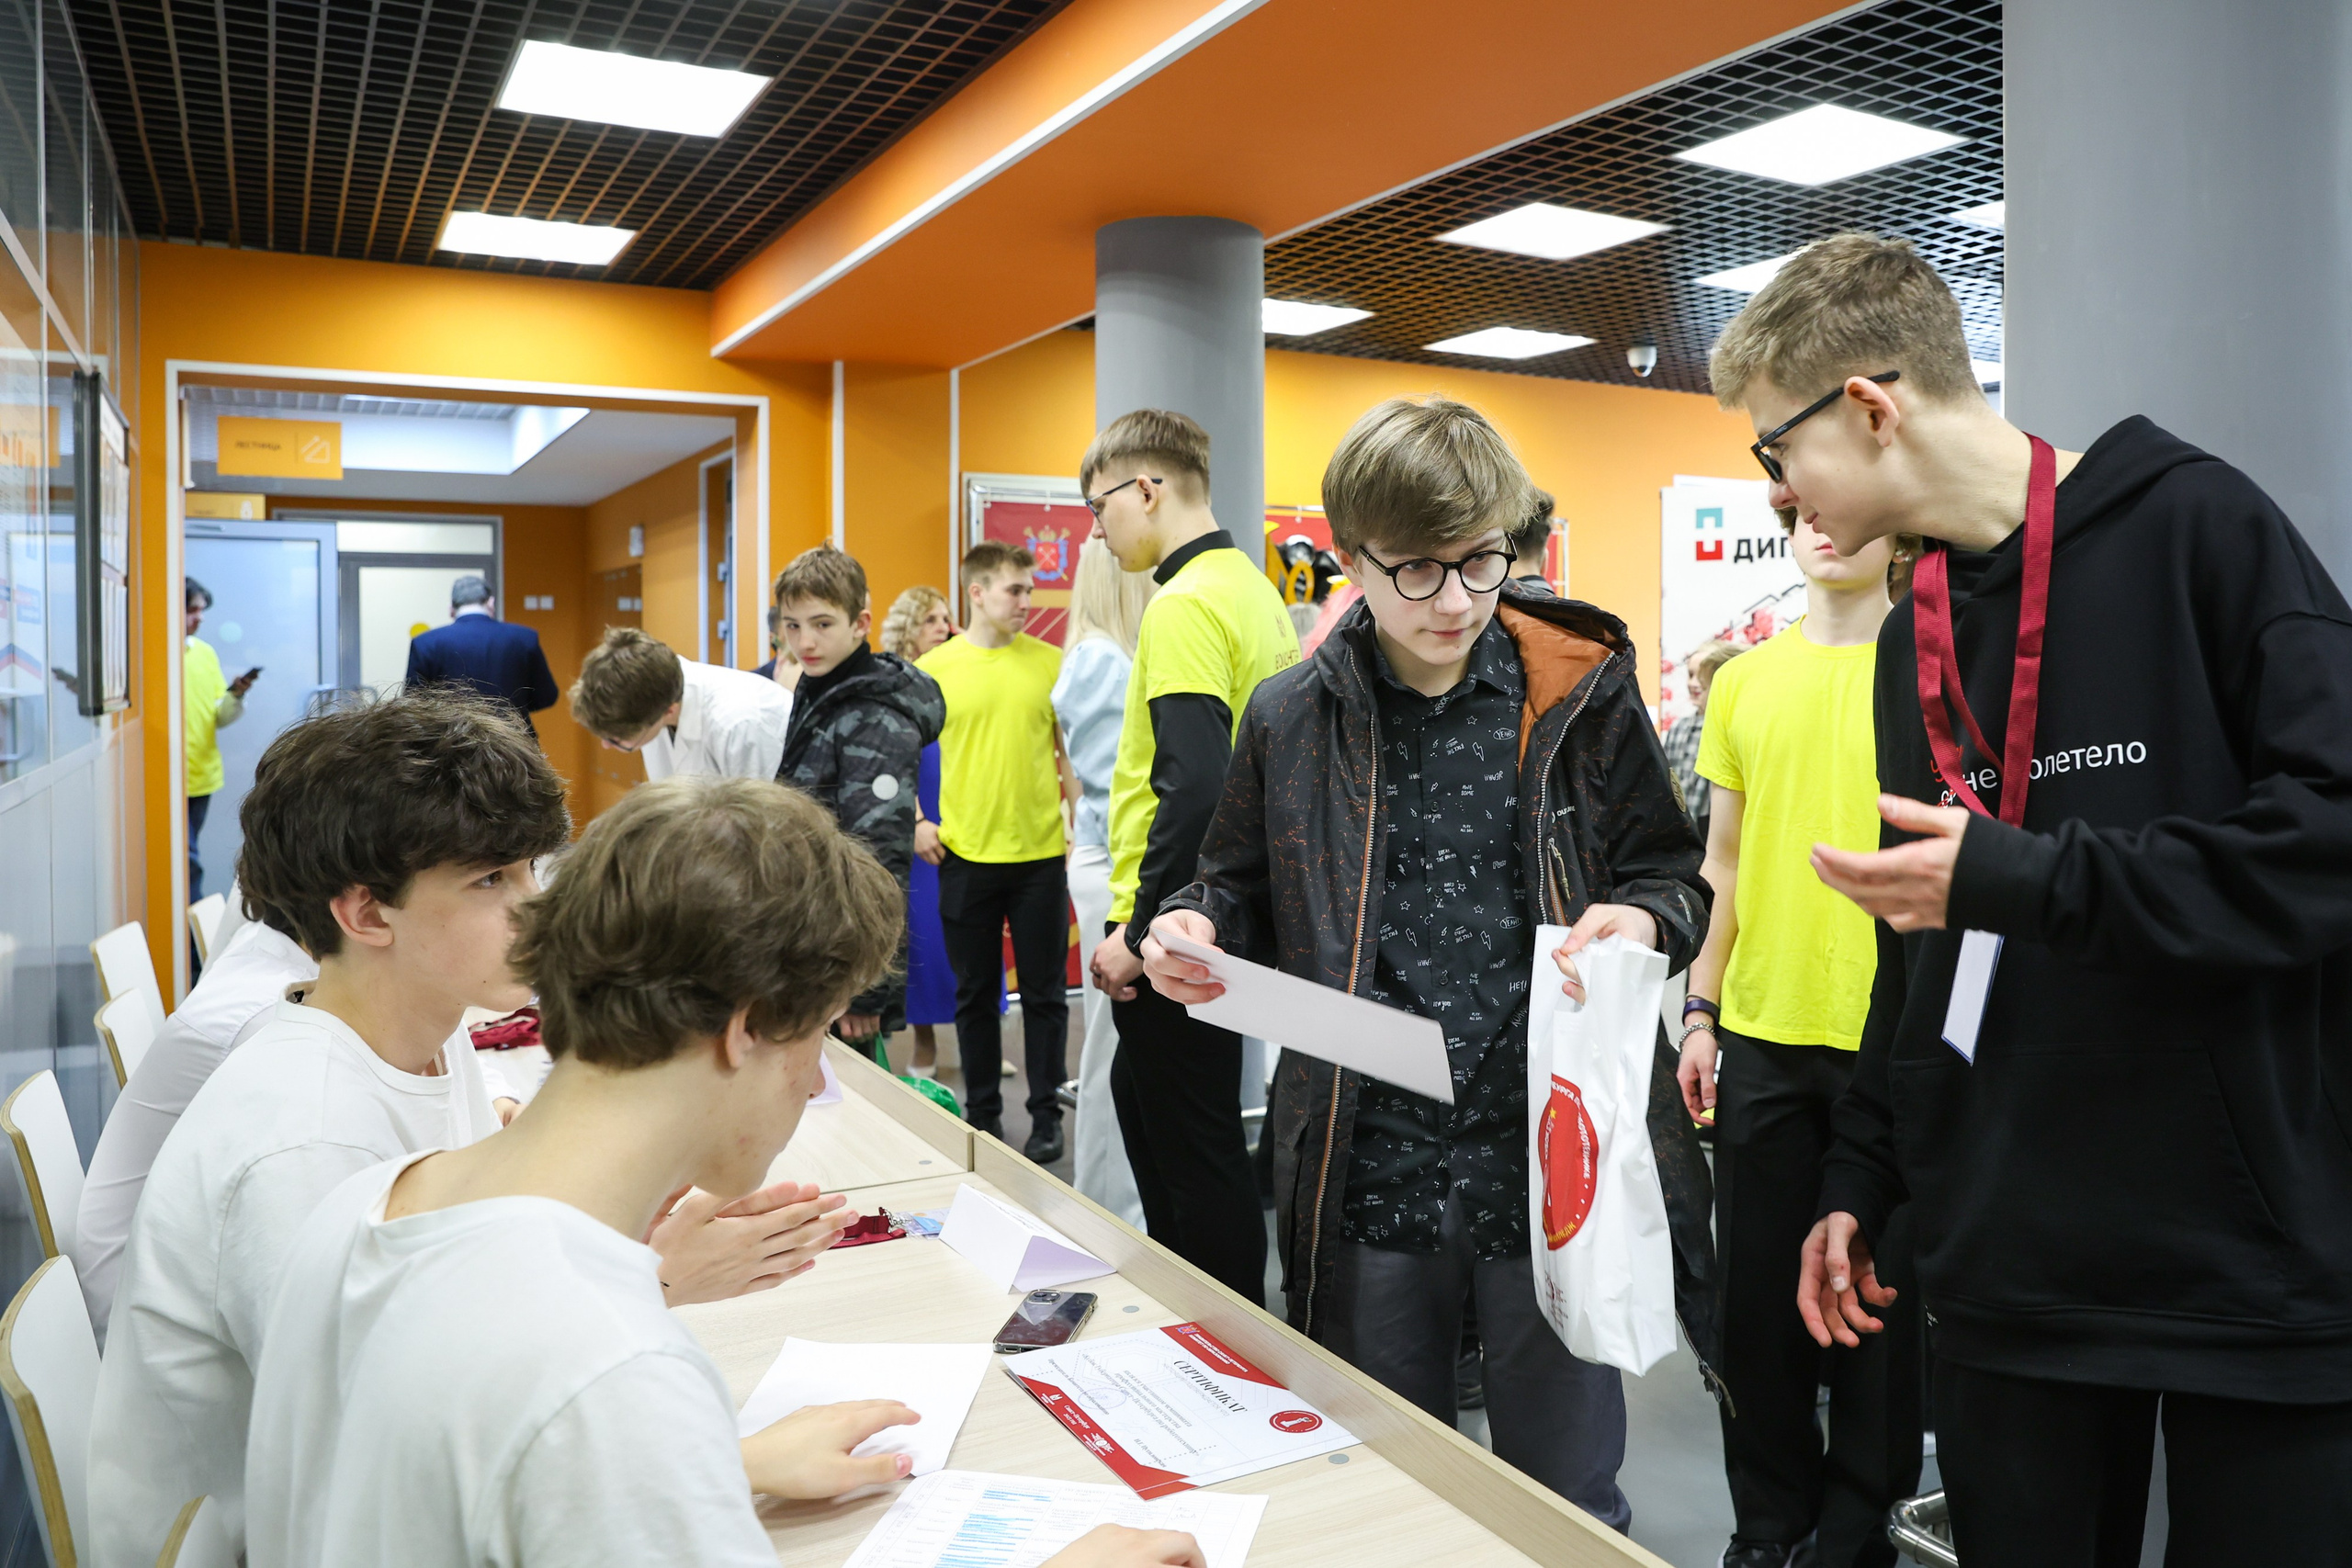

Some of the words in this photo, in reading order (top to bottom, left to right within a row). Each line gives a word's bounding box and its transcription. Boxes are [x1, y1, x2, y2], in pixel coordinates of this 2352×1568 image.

[1734, 536, 1790, 563] ДИП
[2029, 740, 2147, 780] олетело
[1510, 980, 1527, 993] HEY!
[1173, 1359, 1248, 1413] СЕРТИФИКАТ
